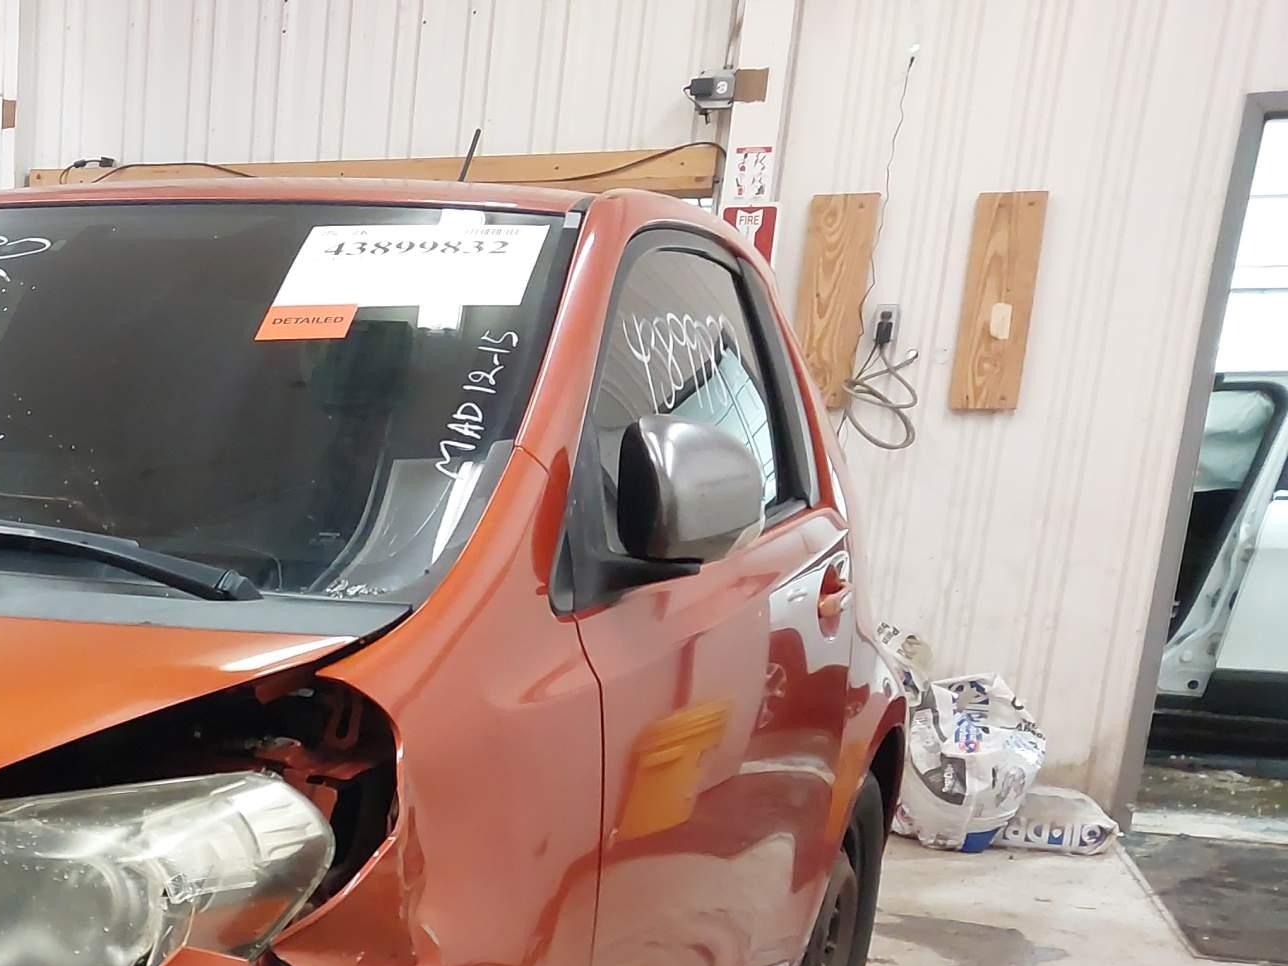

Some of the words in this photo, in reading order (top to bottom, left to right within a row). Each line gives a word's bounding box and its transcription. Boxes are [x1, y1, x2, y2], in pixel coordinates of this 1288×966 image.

[738, 215, 760, 226] FIRE
[324, 240, 510, 256] 43899832
[271, 314, 345, 326] DETAILED
[435, 402, 485, 480] MAD
